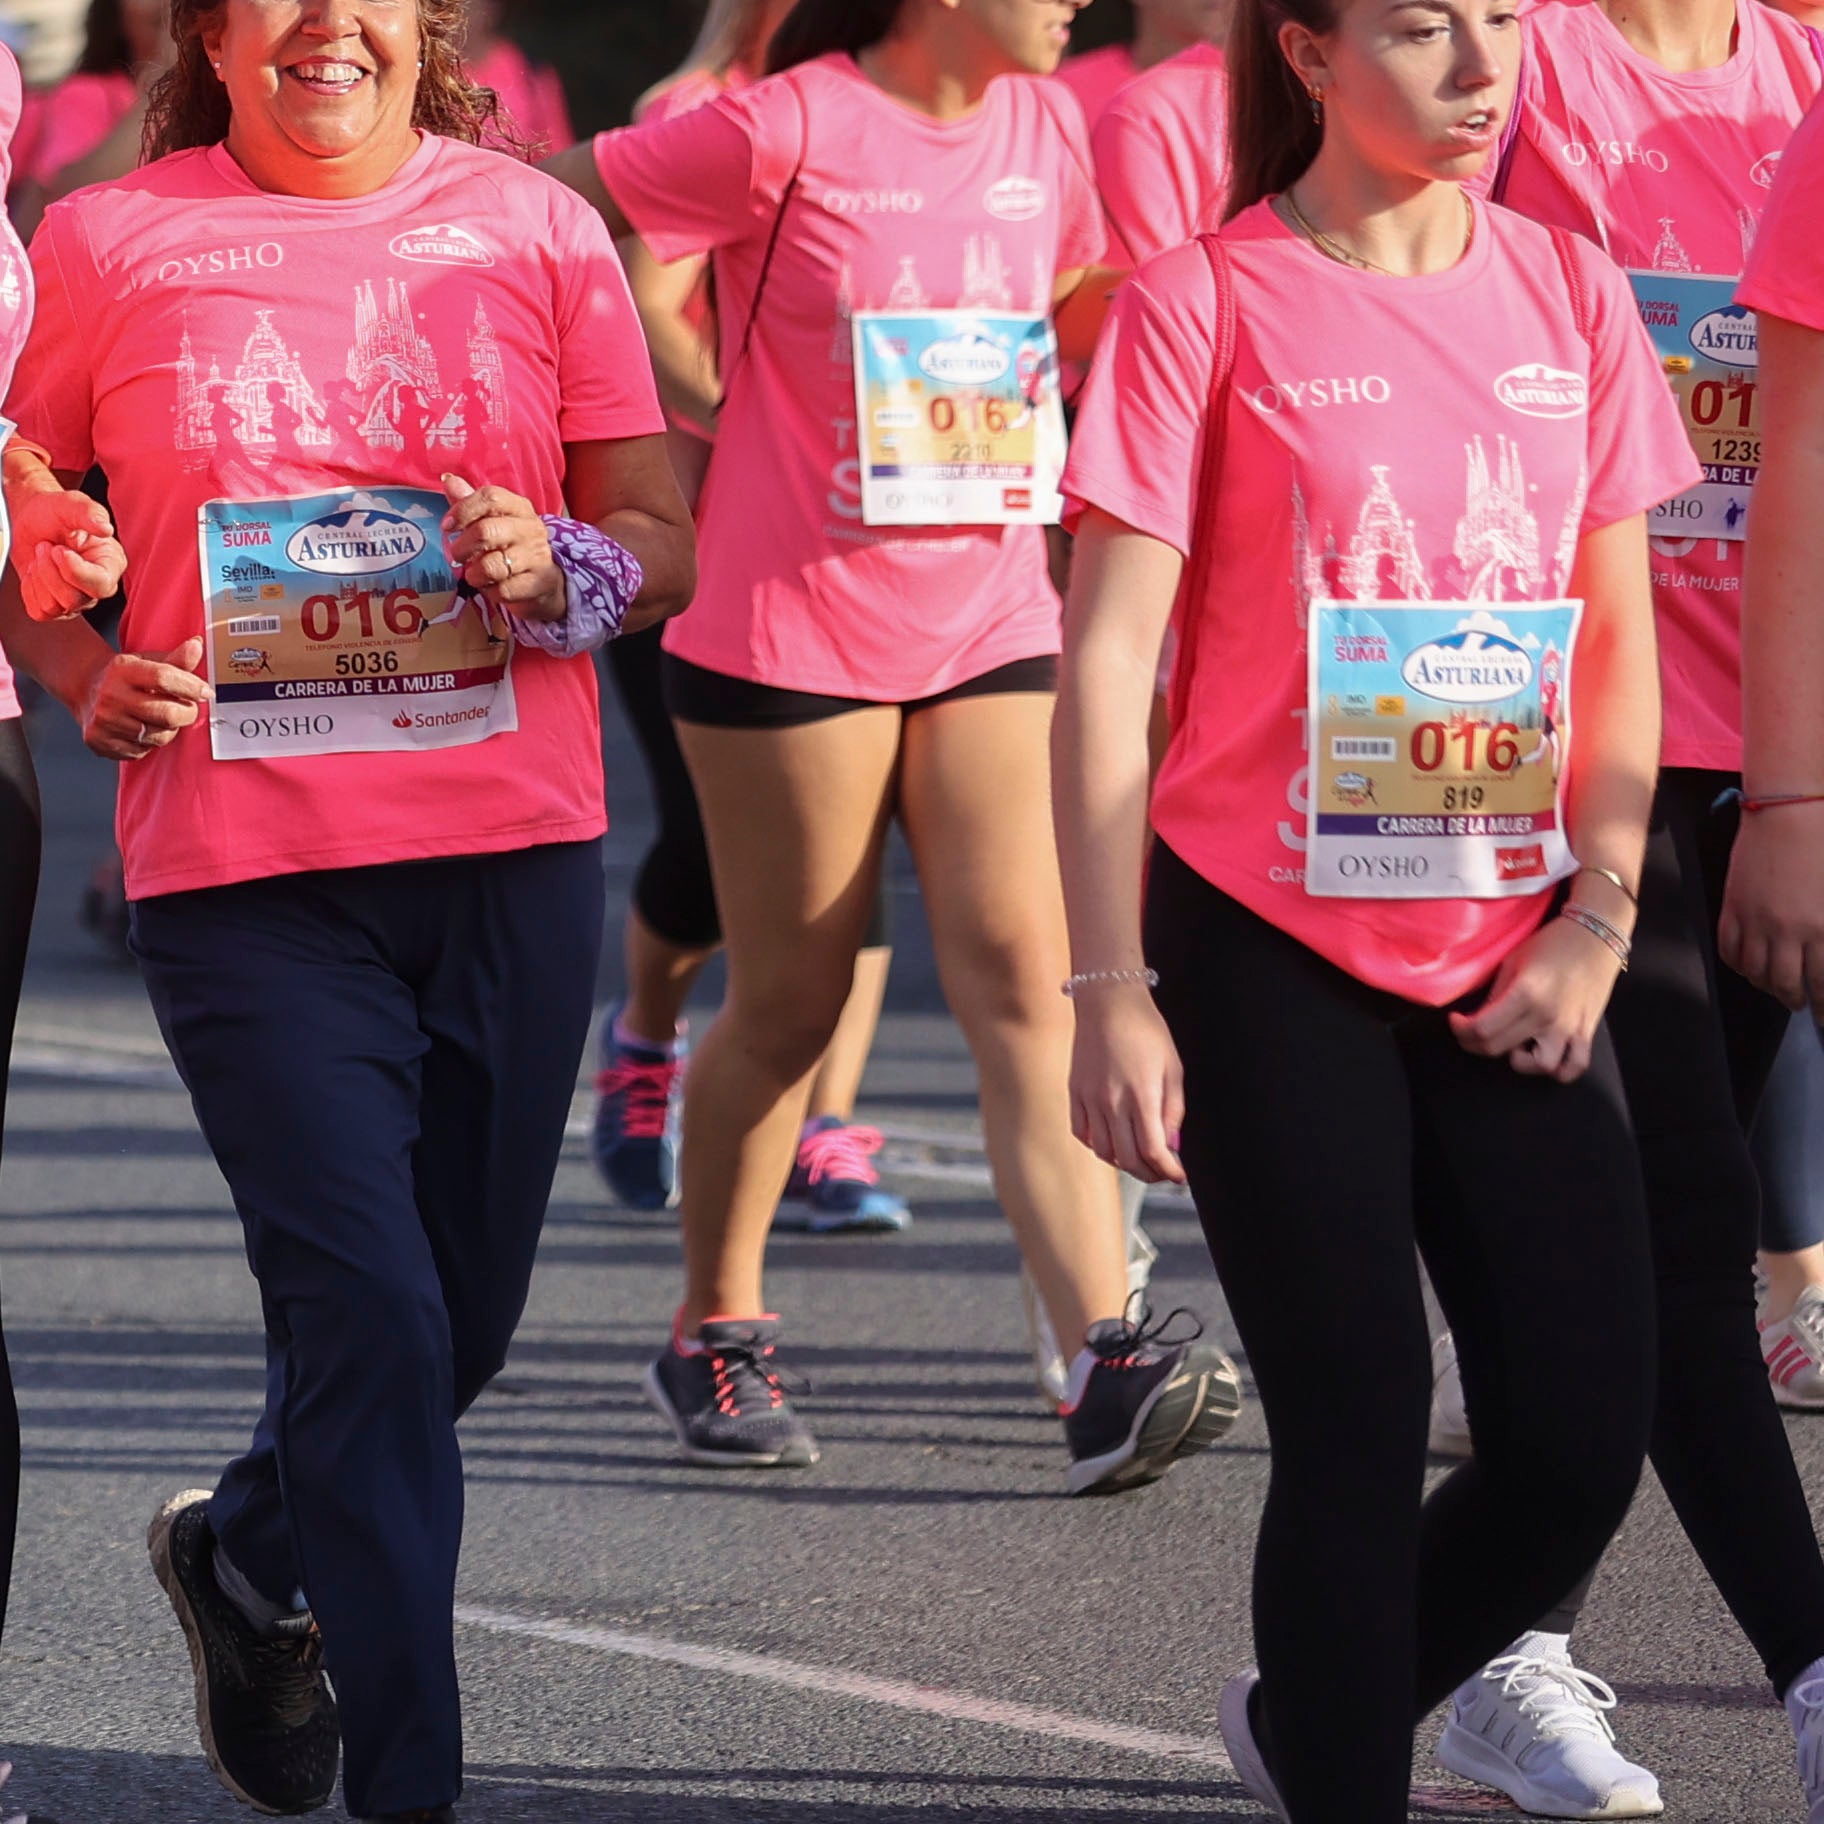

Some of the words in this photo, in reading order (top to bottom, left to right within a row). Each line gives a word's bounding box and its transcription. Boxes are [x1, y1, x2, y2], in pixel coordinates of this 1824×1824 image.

[1561, 141, 1669, 173] OYSHO
[823, 188, 924, 214] OYSHO
[158, 242, 284, 282] OYSHO
[1642, 311, 1678, 327] UMA
[1697, 323, 1758, 351] ASTUR
[1254, 375, 1390, 414] OYSHO
[1503, 381, 1584, 406] ASTURIAN
[1690, 379, 1754, 427] 01
[1721, 467, 1742, 482] DE
[1654, 499, 1703, 519] SHO
[222, 531, 272, 548] SUMA
[317, 529, 364, 540] CENTRAL
[367, 526, 411, 538] LECHERA
[297, 531, 417, 562] ASTURIANA
[1672, 571, 1686, 588] LA
[1688, 574, 1739, 592] MUJER
[300, 588, 423, 642] 016
[335, 650, 399, 675] 5036
[1335, 646, 1389, 663] SUMA
[1413, 656, 1528, 687] ASTURIANA
[274, 682, 348, 698] CARRERA
[353, 680, 372, 694] DE
[377, 679, 398, 693] LA
[403, 674, 456, 691] MUJER
[239, 714, 334, 739] OYSHO
[414, 706, 492, 728] Santander
[1410, 721, 1520, 772] 016
[1443, 785, 1485, 810] 819
[1377, 816, 1444, 835] CARRERA
[1446, 816, 1467, 835] DE
[1468, 816, 1486, 835] LA
[1488, 816, 1533, 834] MUJER
[1339, 854, 1429, 878] OYSHO
